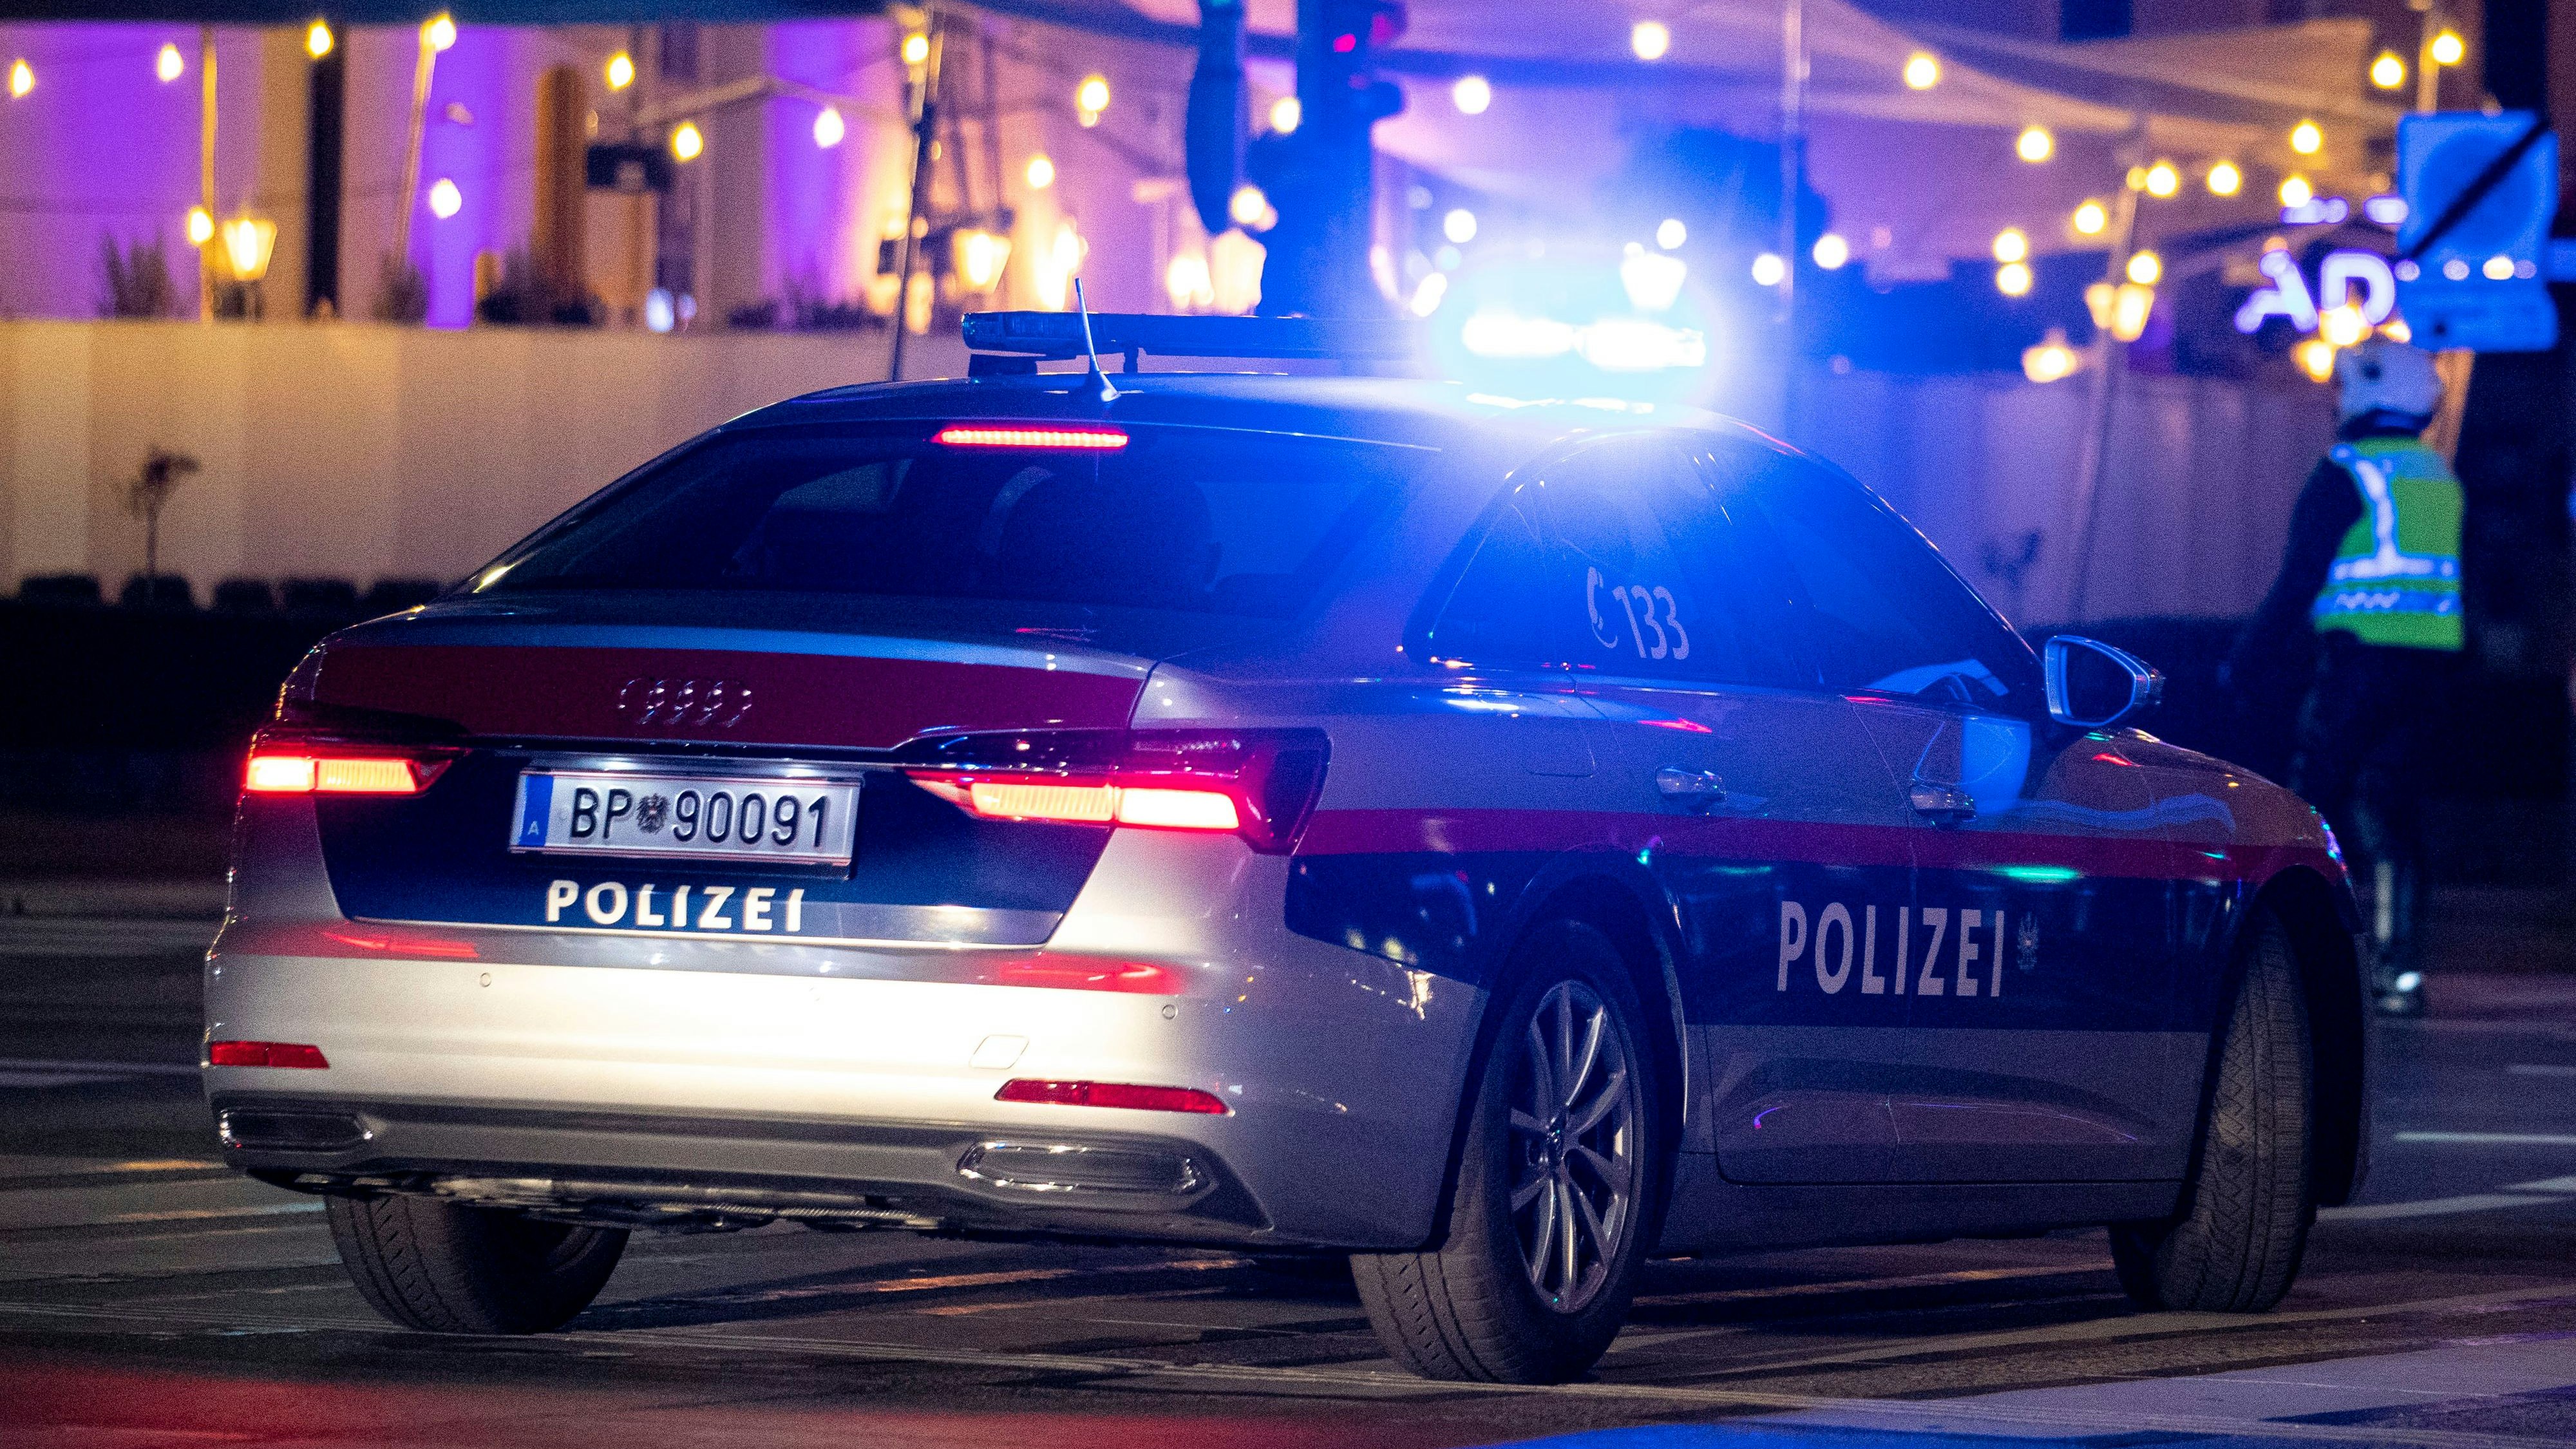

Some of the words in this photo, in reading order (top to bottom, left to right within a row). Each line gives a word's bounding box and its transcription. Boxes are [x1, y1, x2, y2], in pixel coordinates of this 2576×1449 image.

[1611, 585, 1689, 660] 133
[527, 822, 539, 836] A
[570, 787, 633, 839] BP
[672, 789, 829, 848] 90091
[546, 880, 805, 933] POLIZEI
[1777, 901, 2005, 998] POLIZEI
